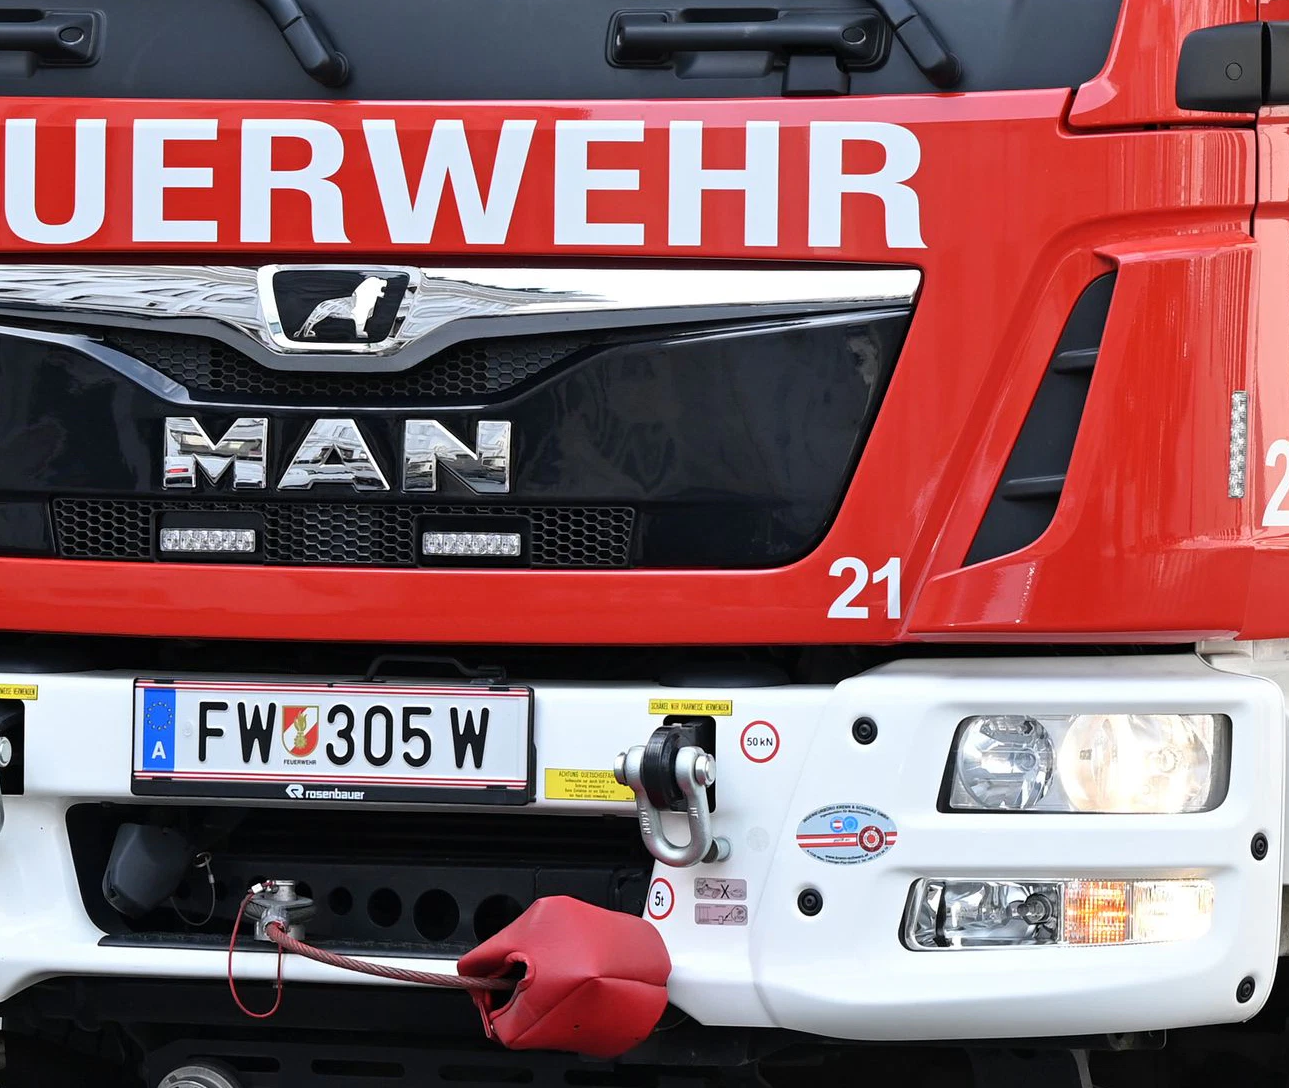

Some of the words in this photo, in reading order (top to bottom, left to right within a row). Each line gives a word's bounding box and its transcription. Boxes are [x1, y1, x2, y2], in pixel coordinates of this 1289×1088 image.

[162, 416, 512, 494] MAN
[827, 556, 902, 620] 21
[198, 701, 277, 764] FW
[326, 704, 432, 768] 305
[449, 707, 490, 769] W
[747, 737, 759, 747] 50
[760, 737, 774, 747] kN
[151, 740, 167, 760] A
[558, 770, 578, 778] ACHTUNG
[581, 771, 615, 779] QUETSCHGEFAH
[305, 788, 365, 800] rosenbauer
